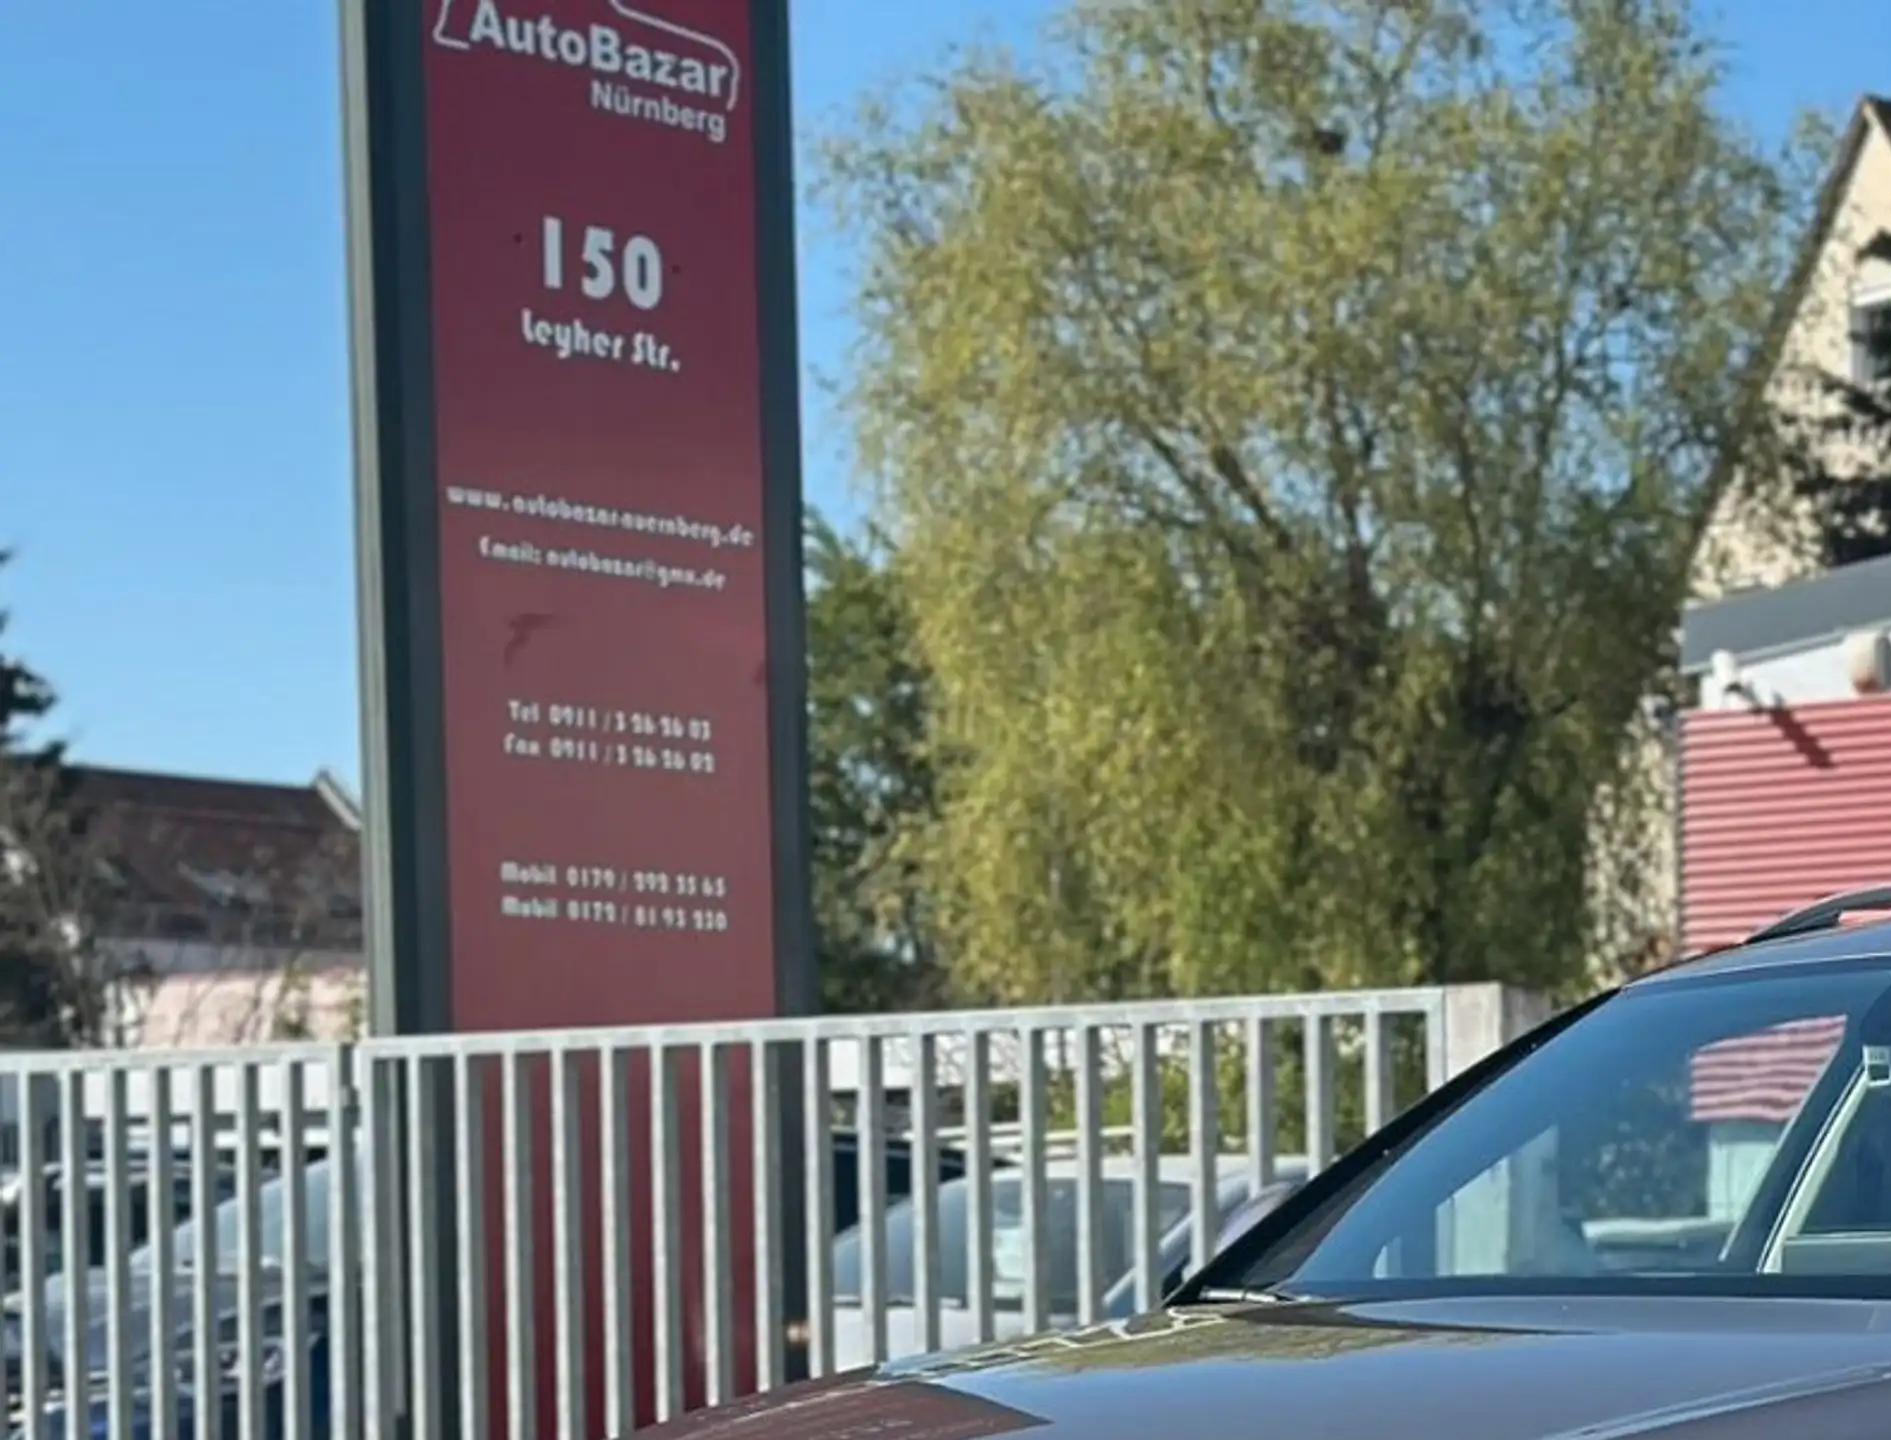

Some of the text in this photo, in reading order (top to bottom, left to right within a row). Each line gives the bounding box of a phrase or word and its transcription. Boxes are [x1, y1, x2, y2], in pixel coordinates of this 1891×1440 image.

[470, 0, 728, 97] AutoBazar
[590, 80, 726, 143] Nürnberg
[521, 308, 681, 372] Leyher Str.
[508, 699, 540, 723] Tel
[500, 861, 557, 886] Mobil
[501, 896, 558, 920] Mobil
